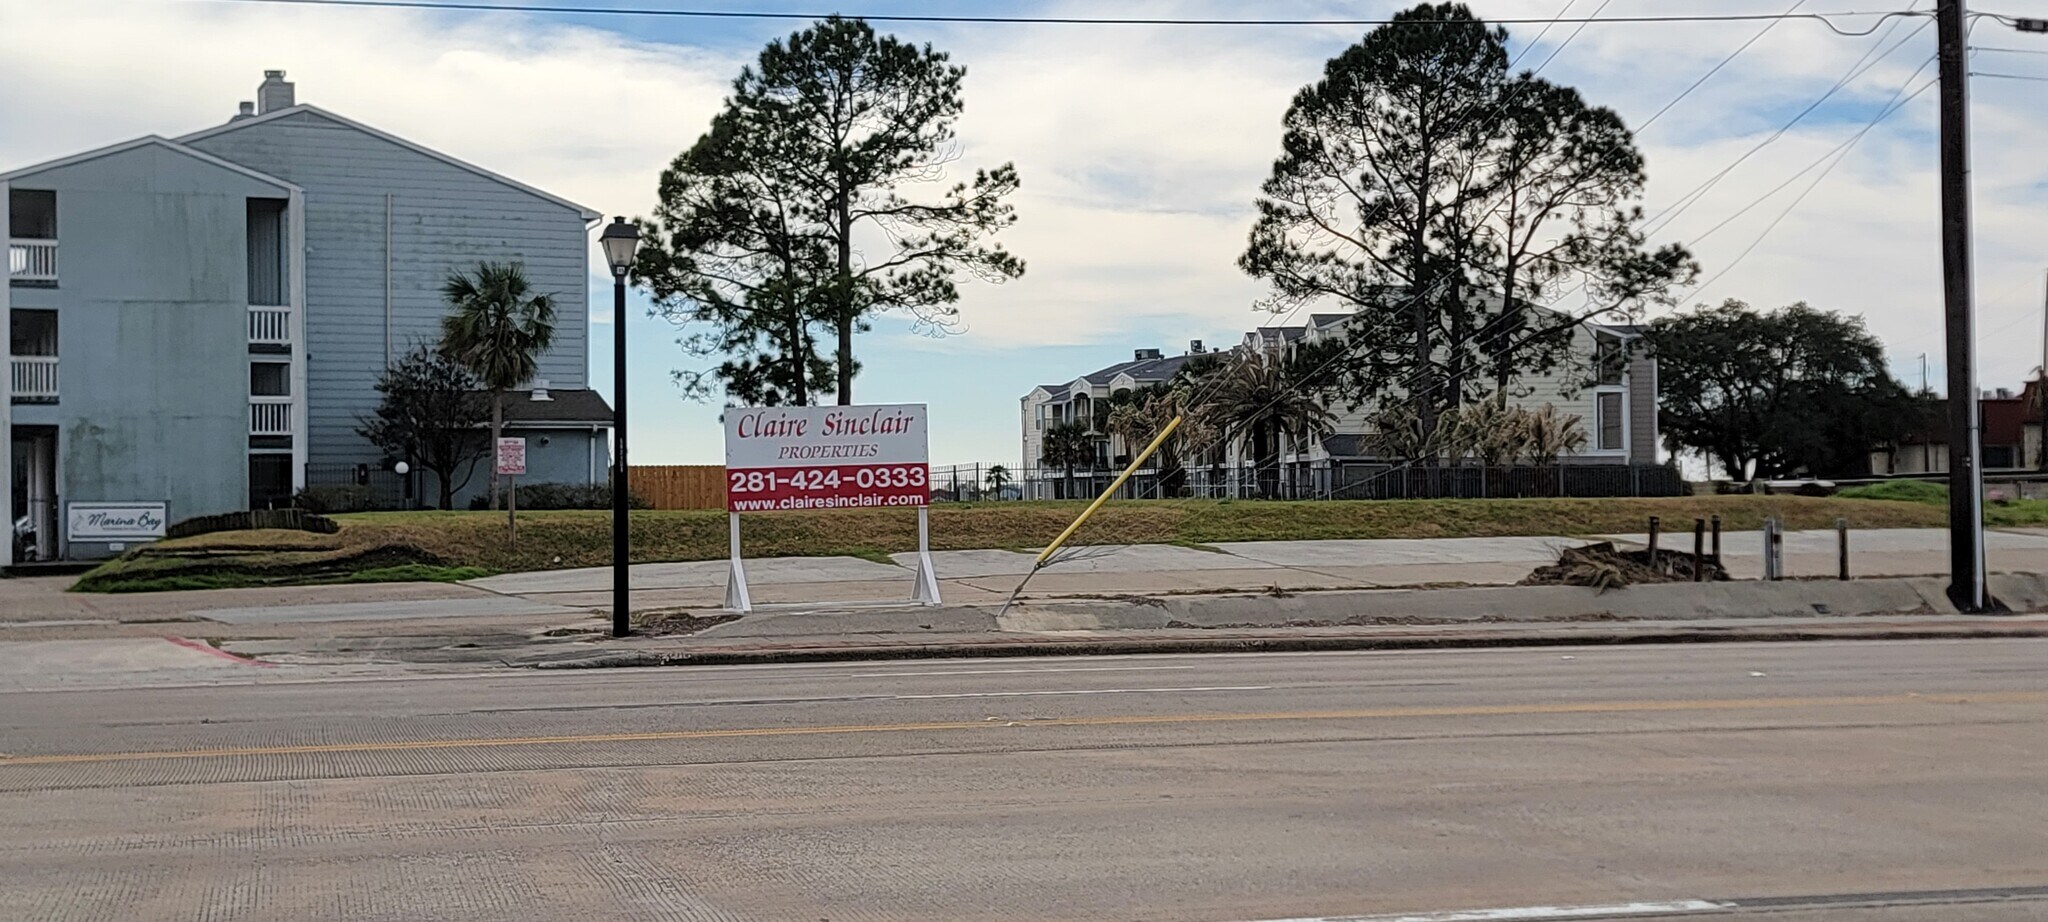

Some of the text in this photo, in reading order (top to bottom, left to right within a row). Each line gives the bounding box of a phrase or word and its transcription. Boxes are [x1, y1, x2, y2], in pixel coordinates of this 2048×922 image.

[738, 408, 914, 438] Claire Sinclair
[778, 443, 879, 460] PROPERTIES
[730, 466, 926, 493] 281-424-0333
[734, 493, 924, 511] www.clairesinclair.com
[88, 511, 162, 531] Marina Bay
